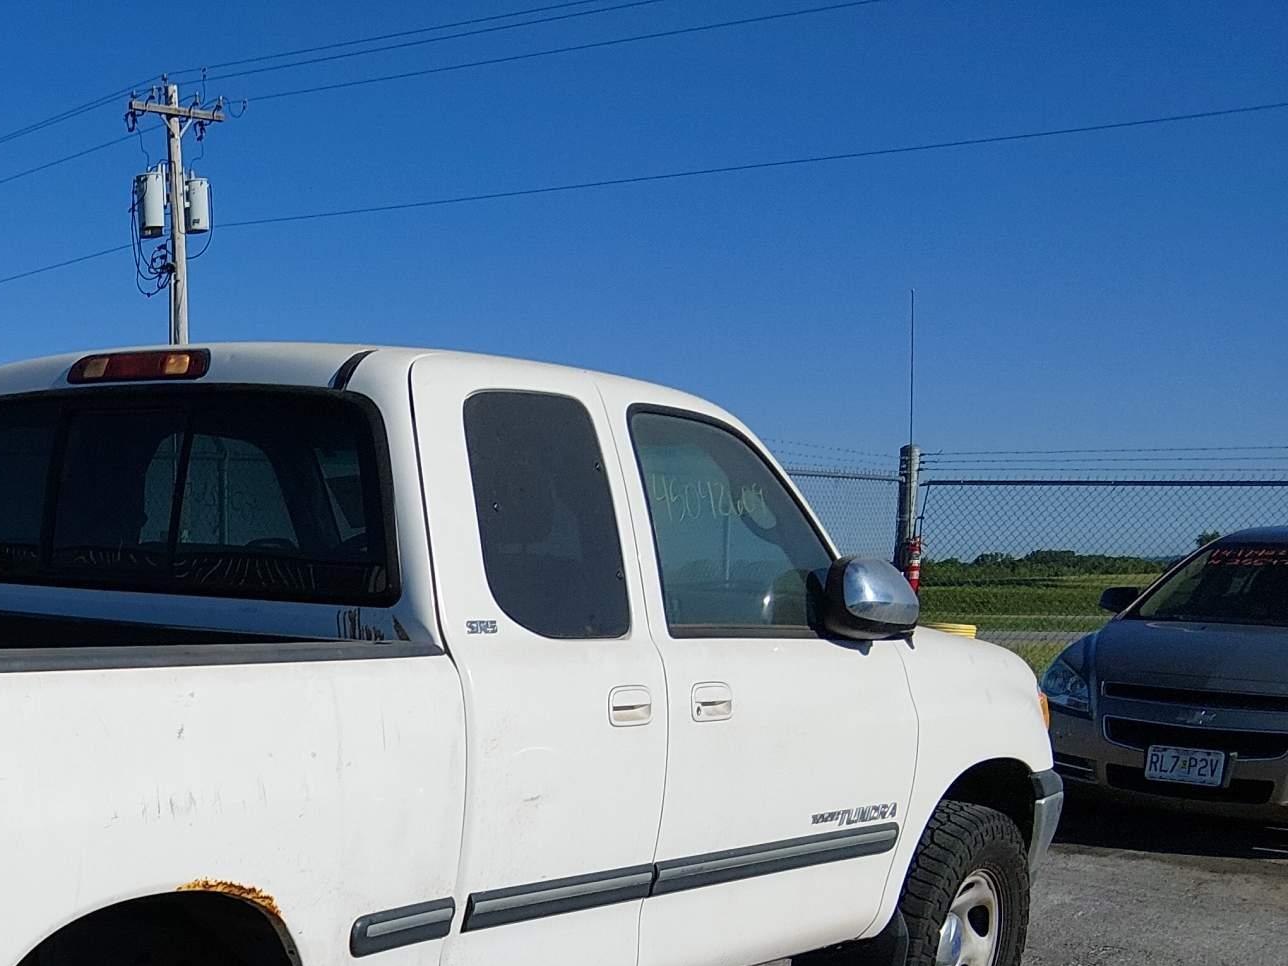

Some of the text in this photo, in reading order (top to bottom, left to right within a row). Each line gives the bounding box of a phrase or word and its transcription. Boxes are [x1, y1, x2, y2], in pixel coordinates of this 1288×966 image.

[466, 620, 498, 634] SR5
[1149, 753, 1218, 777] RL7 P2V
[839, 802, 897, 826] TUNDRA
